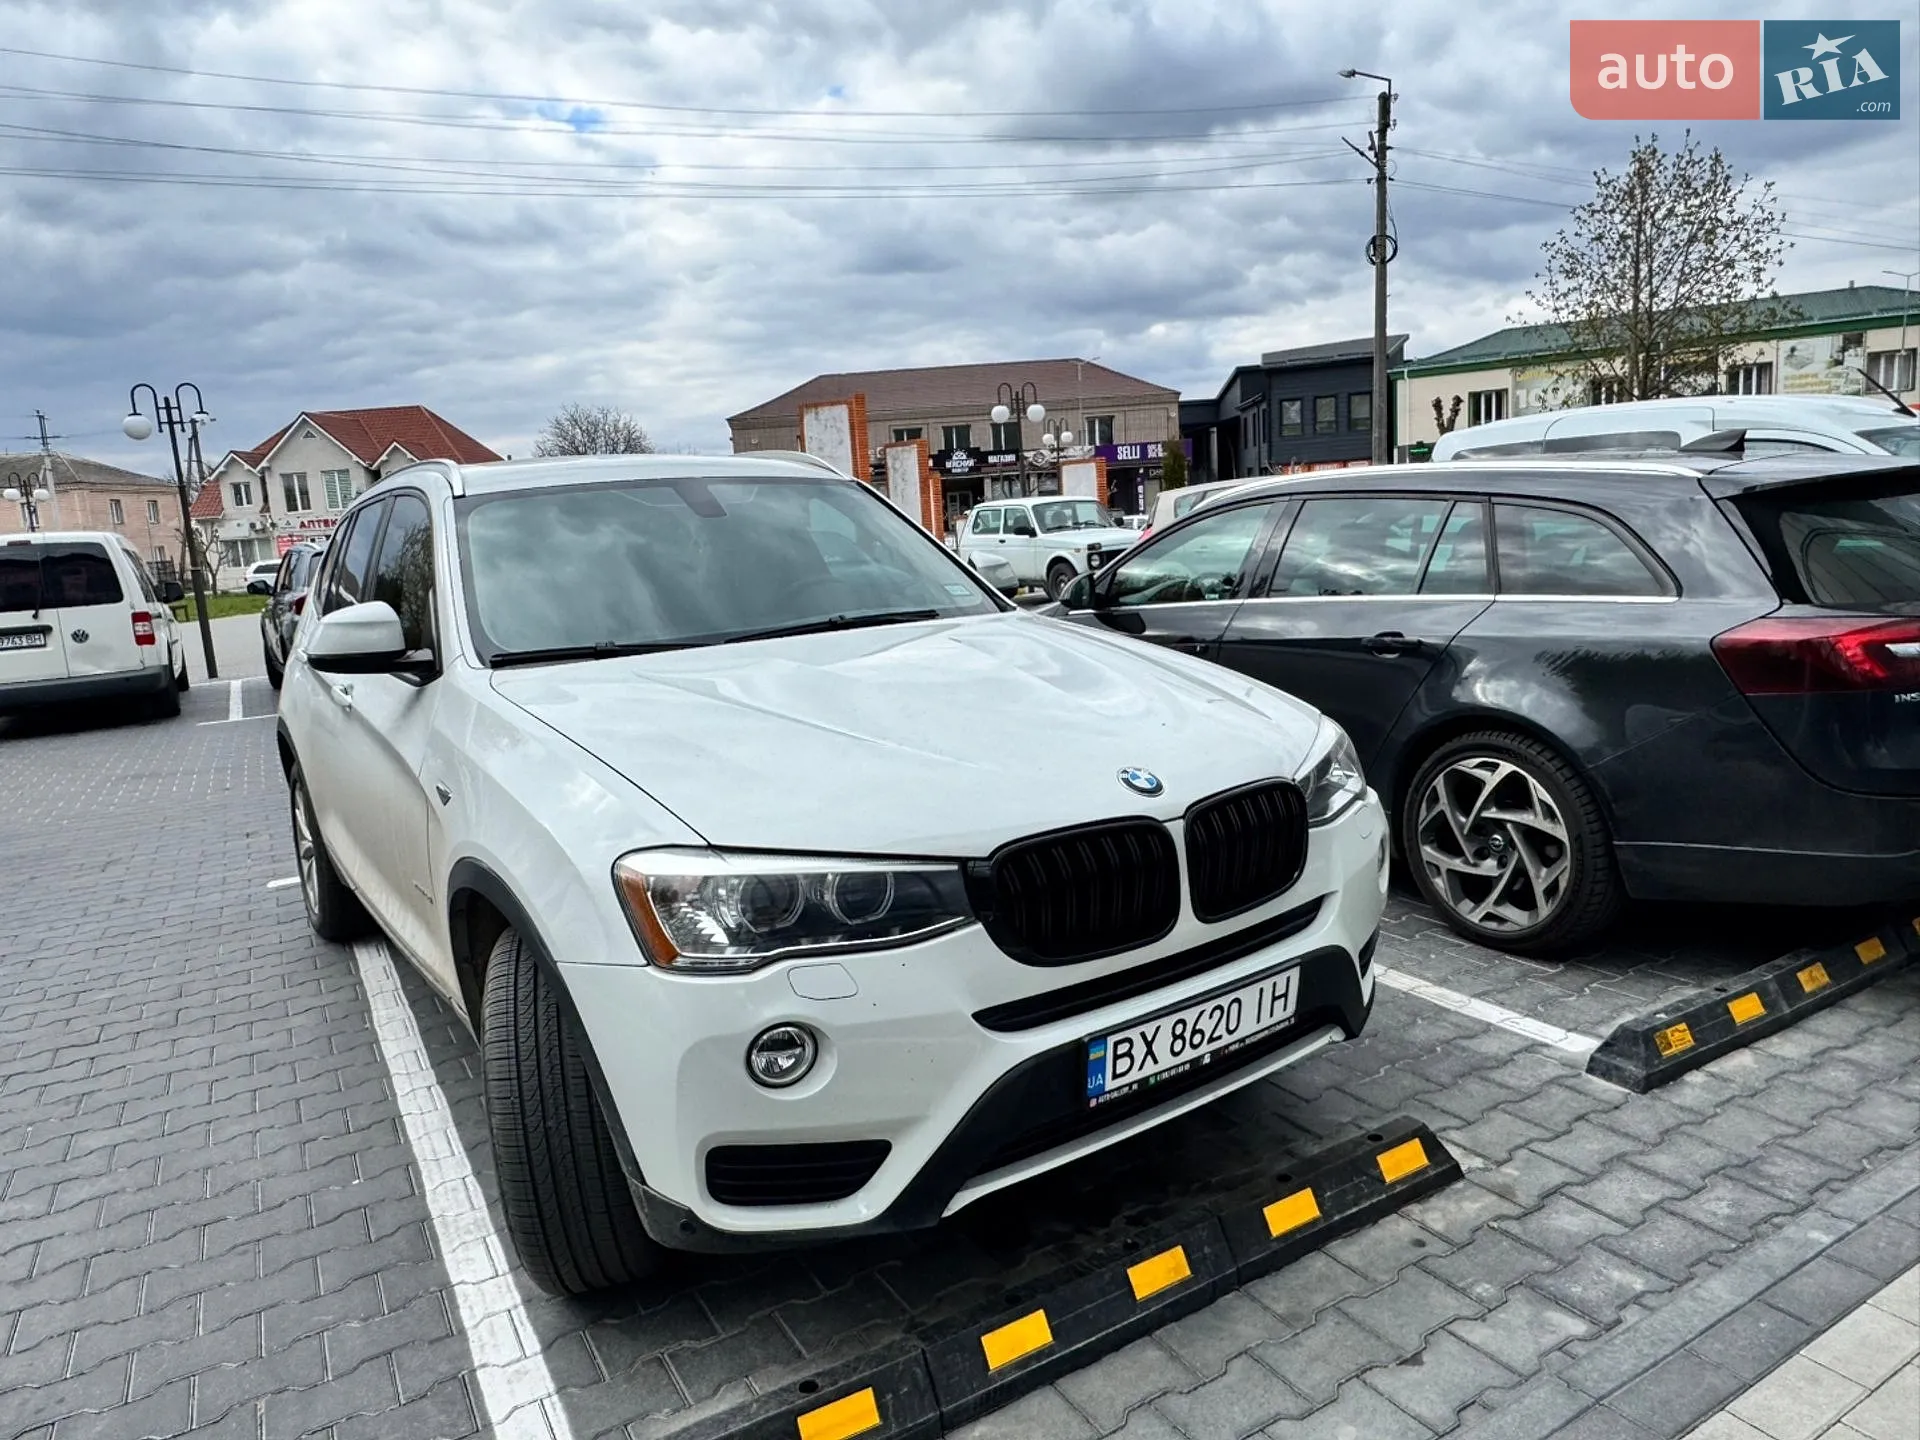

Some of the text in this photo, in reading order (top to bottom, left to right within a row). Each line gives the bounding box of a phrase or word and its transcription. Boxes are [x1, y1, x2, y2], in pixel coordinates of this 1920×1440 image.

[299, 518, 339, 530] АПТЕК
[1111, 1024, 1161, 1081] BX
[1169, 997, 1242, 1058] 8620
[1255, 975, 1291, 1025] IH
[1087, 1072, 1104, 1089] UA
